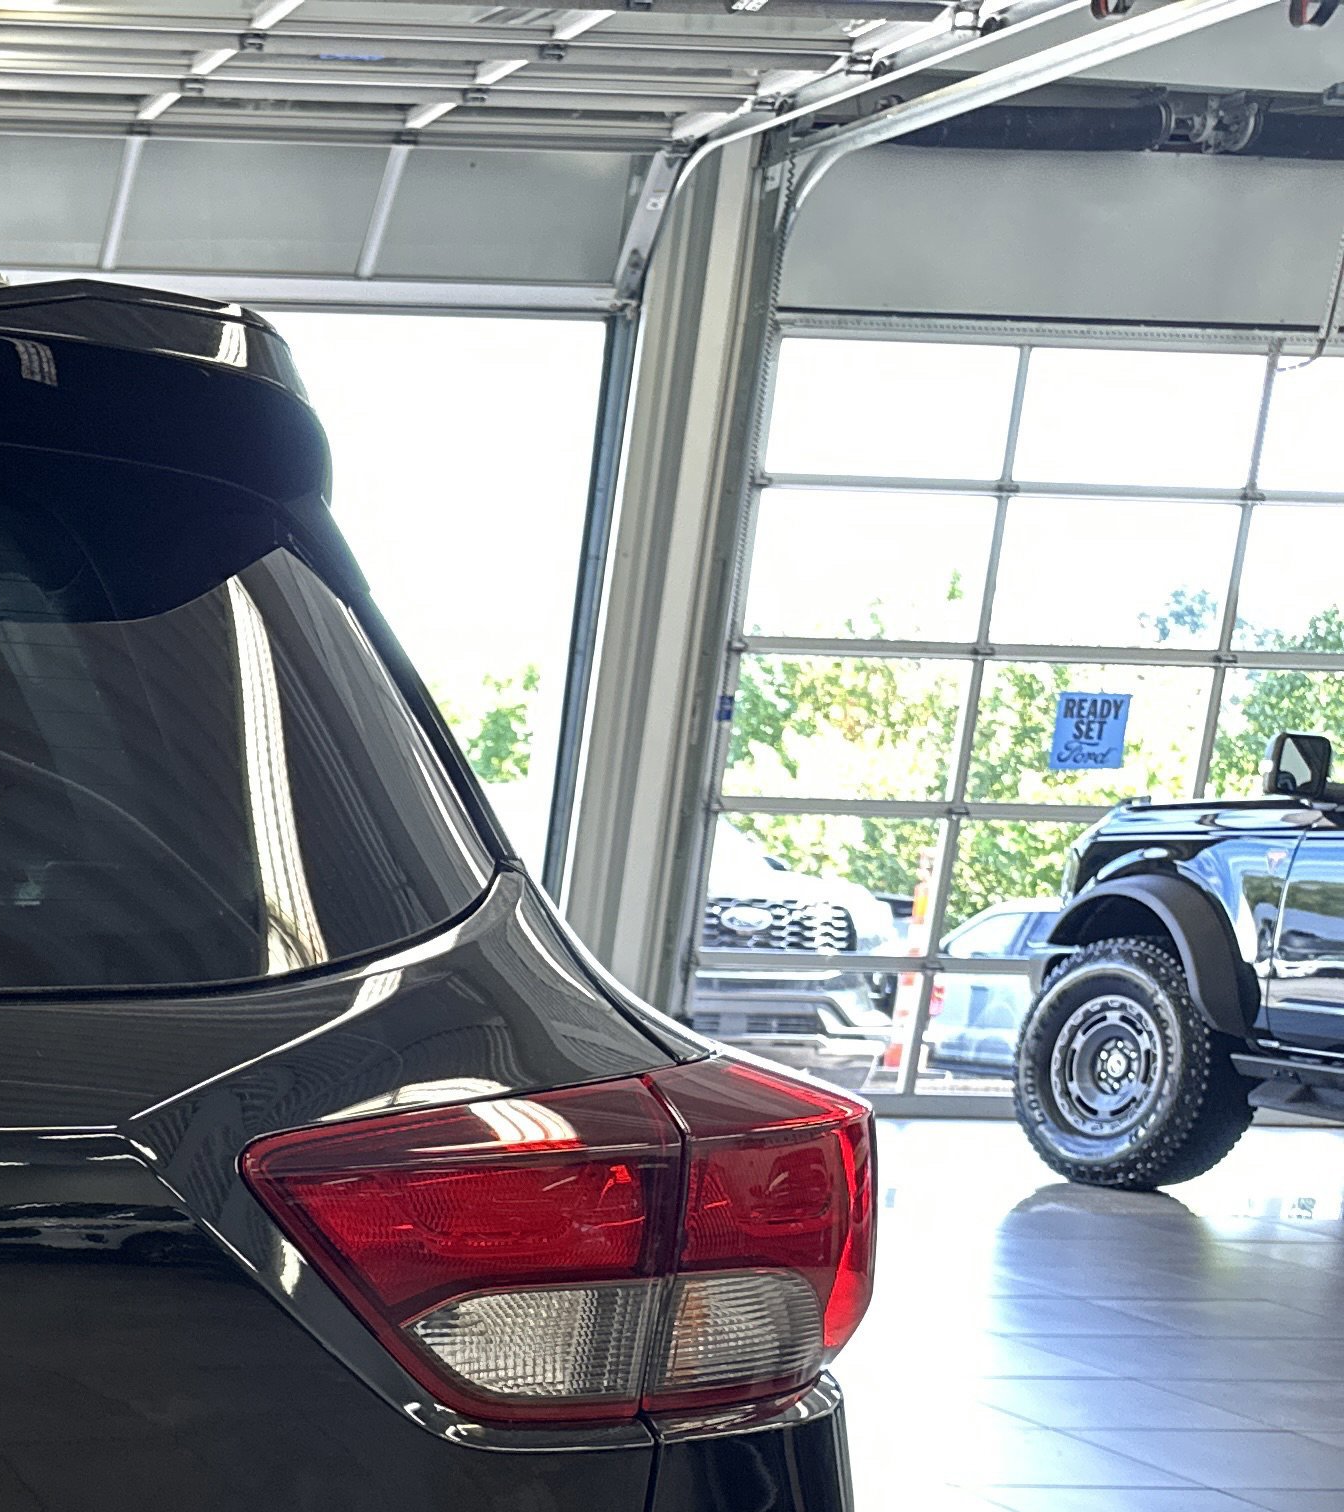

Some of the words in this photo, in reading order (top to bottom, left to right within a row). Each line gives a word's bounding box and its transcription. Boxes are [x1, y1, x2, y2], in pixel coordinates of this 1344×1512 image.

[1063, 698, 1124, 720] READY
[1073, 719, 1107, 740] SET
[1056, 740, 1118, 764] Ford
